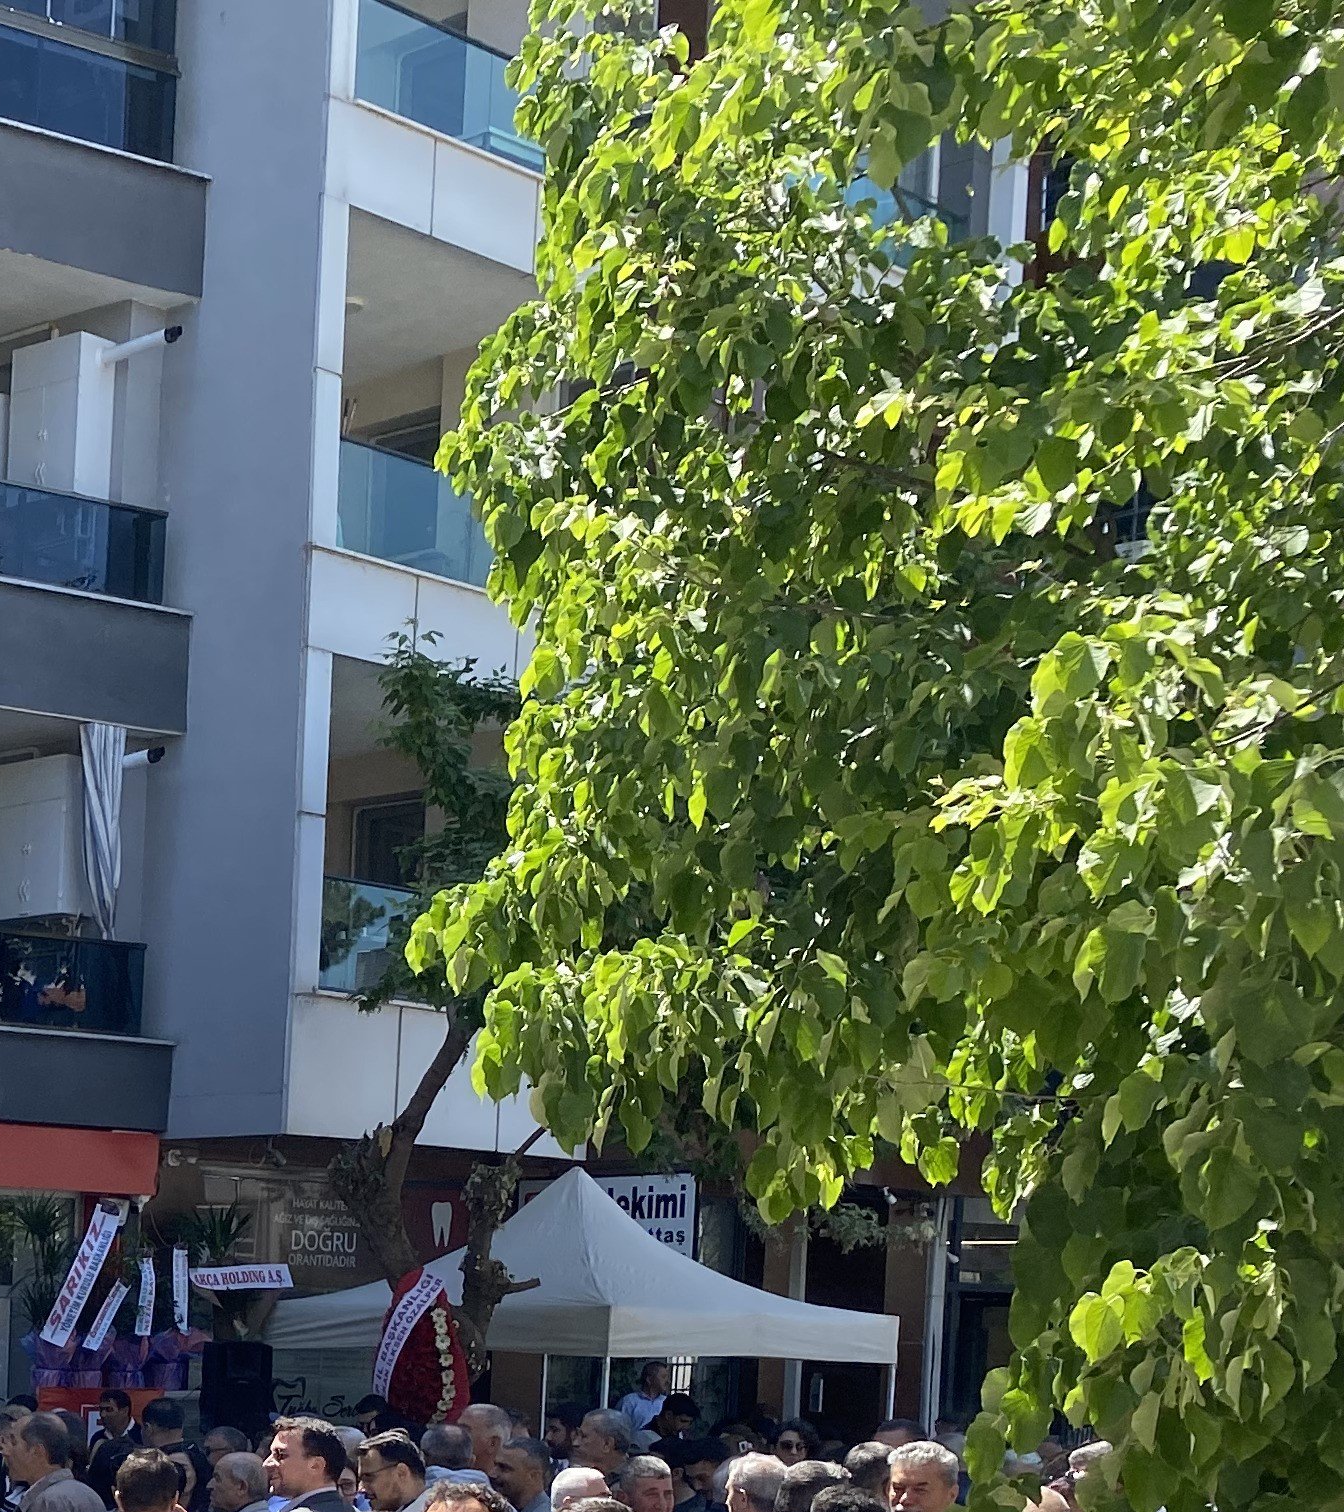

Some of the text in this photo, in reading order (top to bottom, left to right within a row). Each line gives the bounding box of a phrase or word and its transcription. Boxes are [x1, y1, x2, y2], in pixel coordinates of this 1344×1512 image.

[291, 1227, 357, 1253] DOĞRU
[288, 1253, 356, 1268] ORANTIDADIR
[48, 1221, 101, 1327] SARIKIZ
